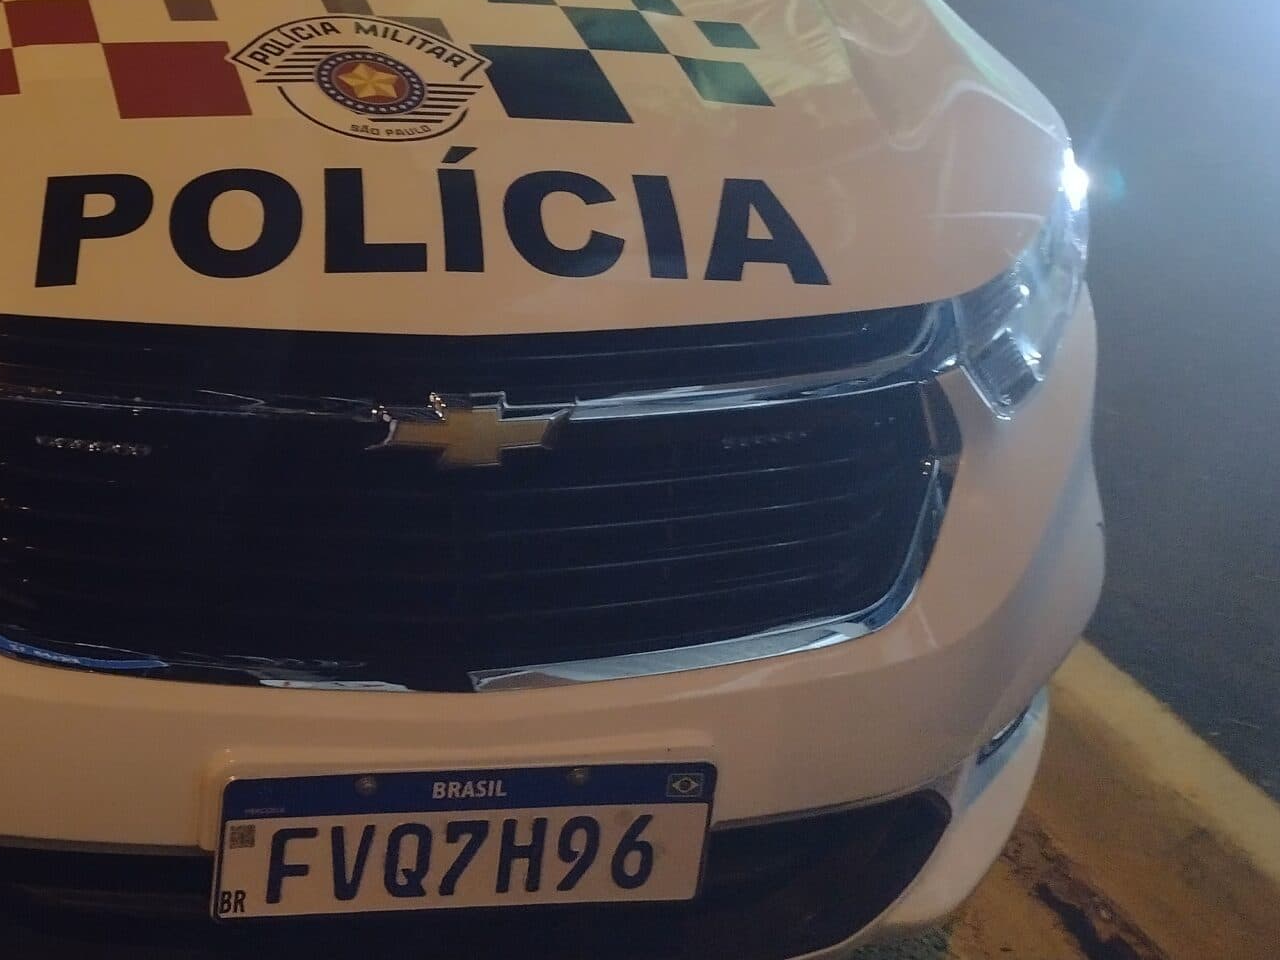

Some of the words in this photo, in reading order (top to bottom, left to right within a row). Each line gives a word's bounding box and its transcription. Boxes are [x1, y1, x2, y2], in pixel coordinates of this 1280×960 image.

[250, 20, 342, 66] POLÍCIA
[354, 21, 467, 69] MILITAR
[350, 122, 380, 137] SÃO
[385, 123, 432, 137] PAULO
[34, 146, 832, 288] POLÍCIA
[431, 778, 508, 800] BRASIL
[265, 813, 656, 905] FVQ7H96
[219, 889, 246, 914] BR
